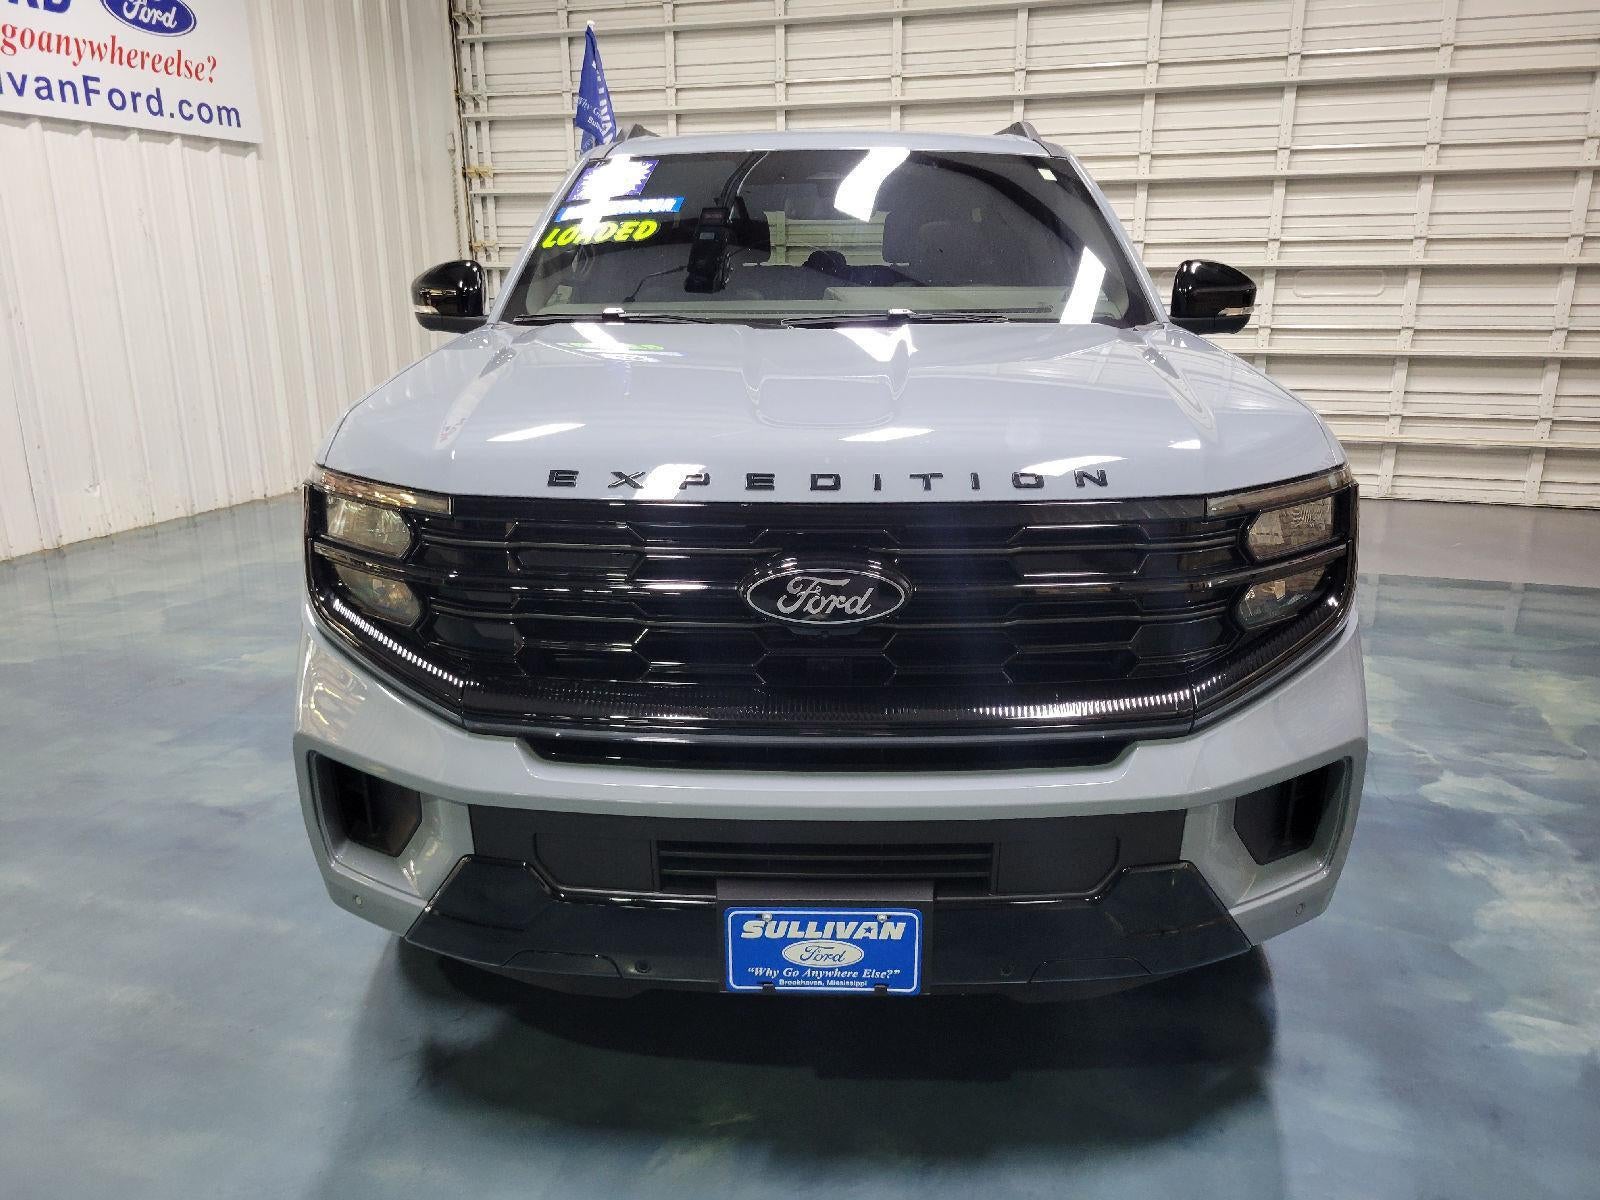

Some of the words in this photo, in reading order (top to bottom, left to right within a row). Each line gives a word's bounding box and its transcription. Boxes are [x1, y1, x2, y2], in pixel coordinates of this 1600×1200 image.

[547, 469, 1109, 491] EXPEDITION
[776, 577, 875, 616] Ford
[740, 920, 907, 940] SULLIVAN
[799, 945, 846, 963] Ford
[783, 967, 799, 978] Go
[801, 968, 859, 979] Anywhere
